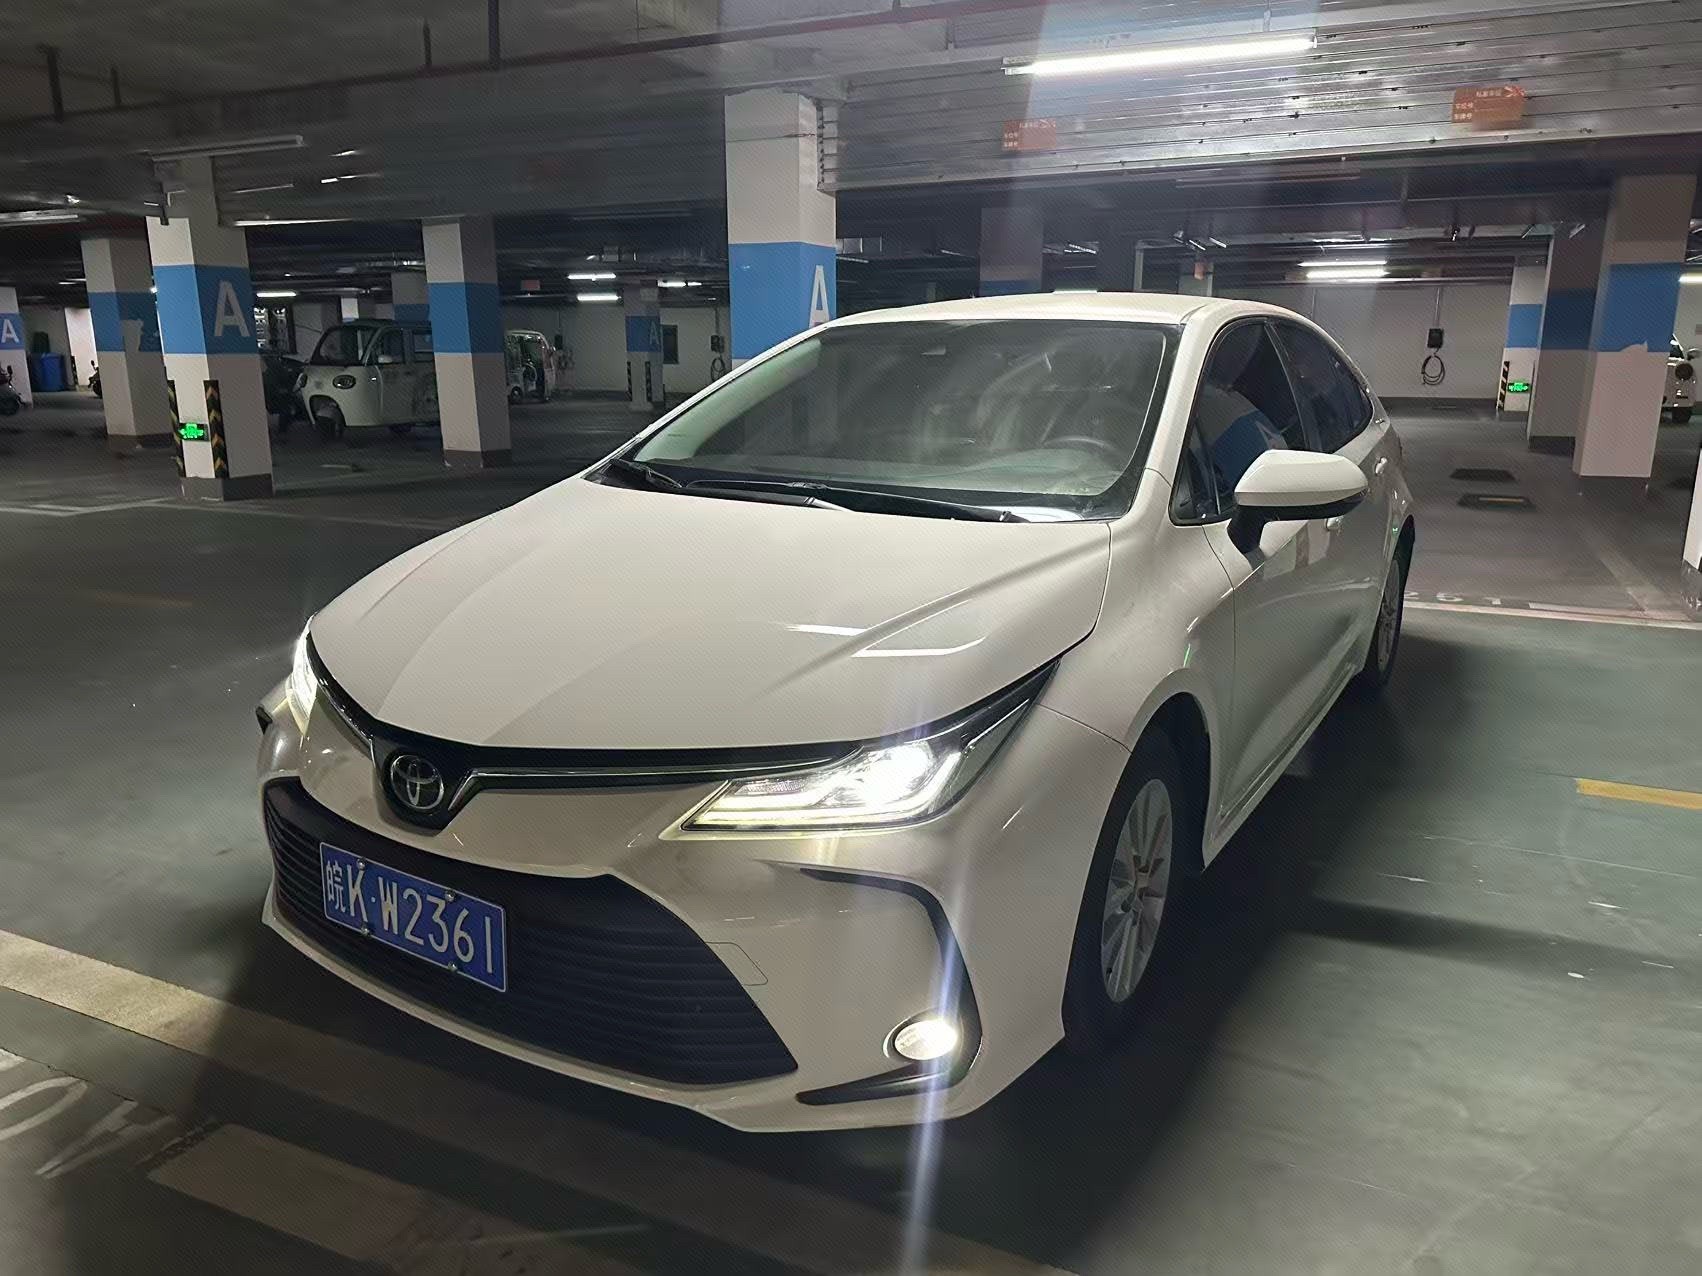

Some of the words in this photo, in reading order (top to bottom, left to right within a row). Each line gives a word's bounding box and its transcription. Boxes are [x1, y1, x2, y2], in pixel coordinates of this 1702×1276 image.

[213, 280, 250, 337] A
[809, 265, 830, 328] A
[1, 318, 20, 344] A
